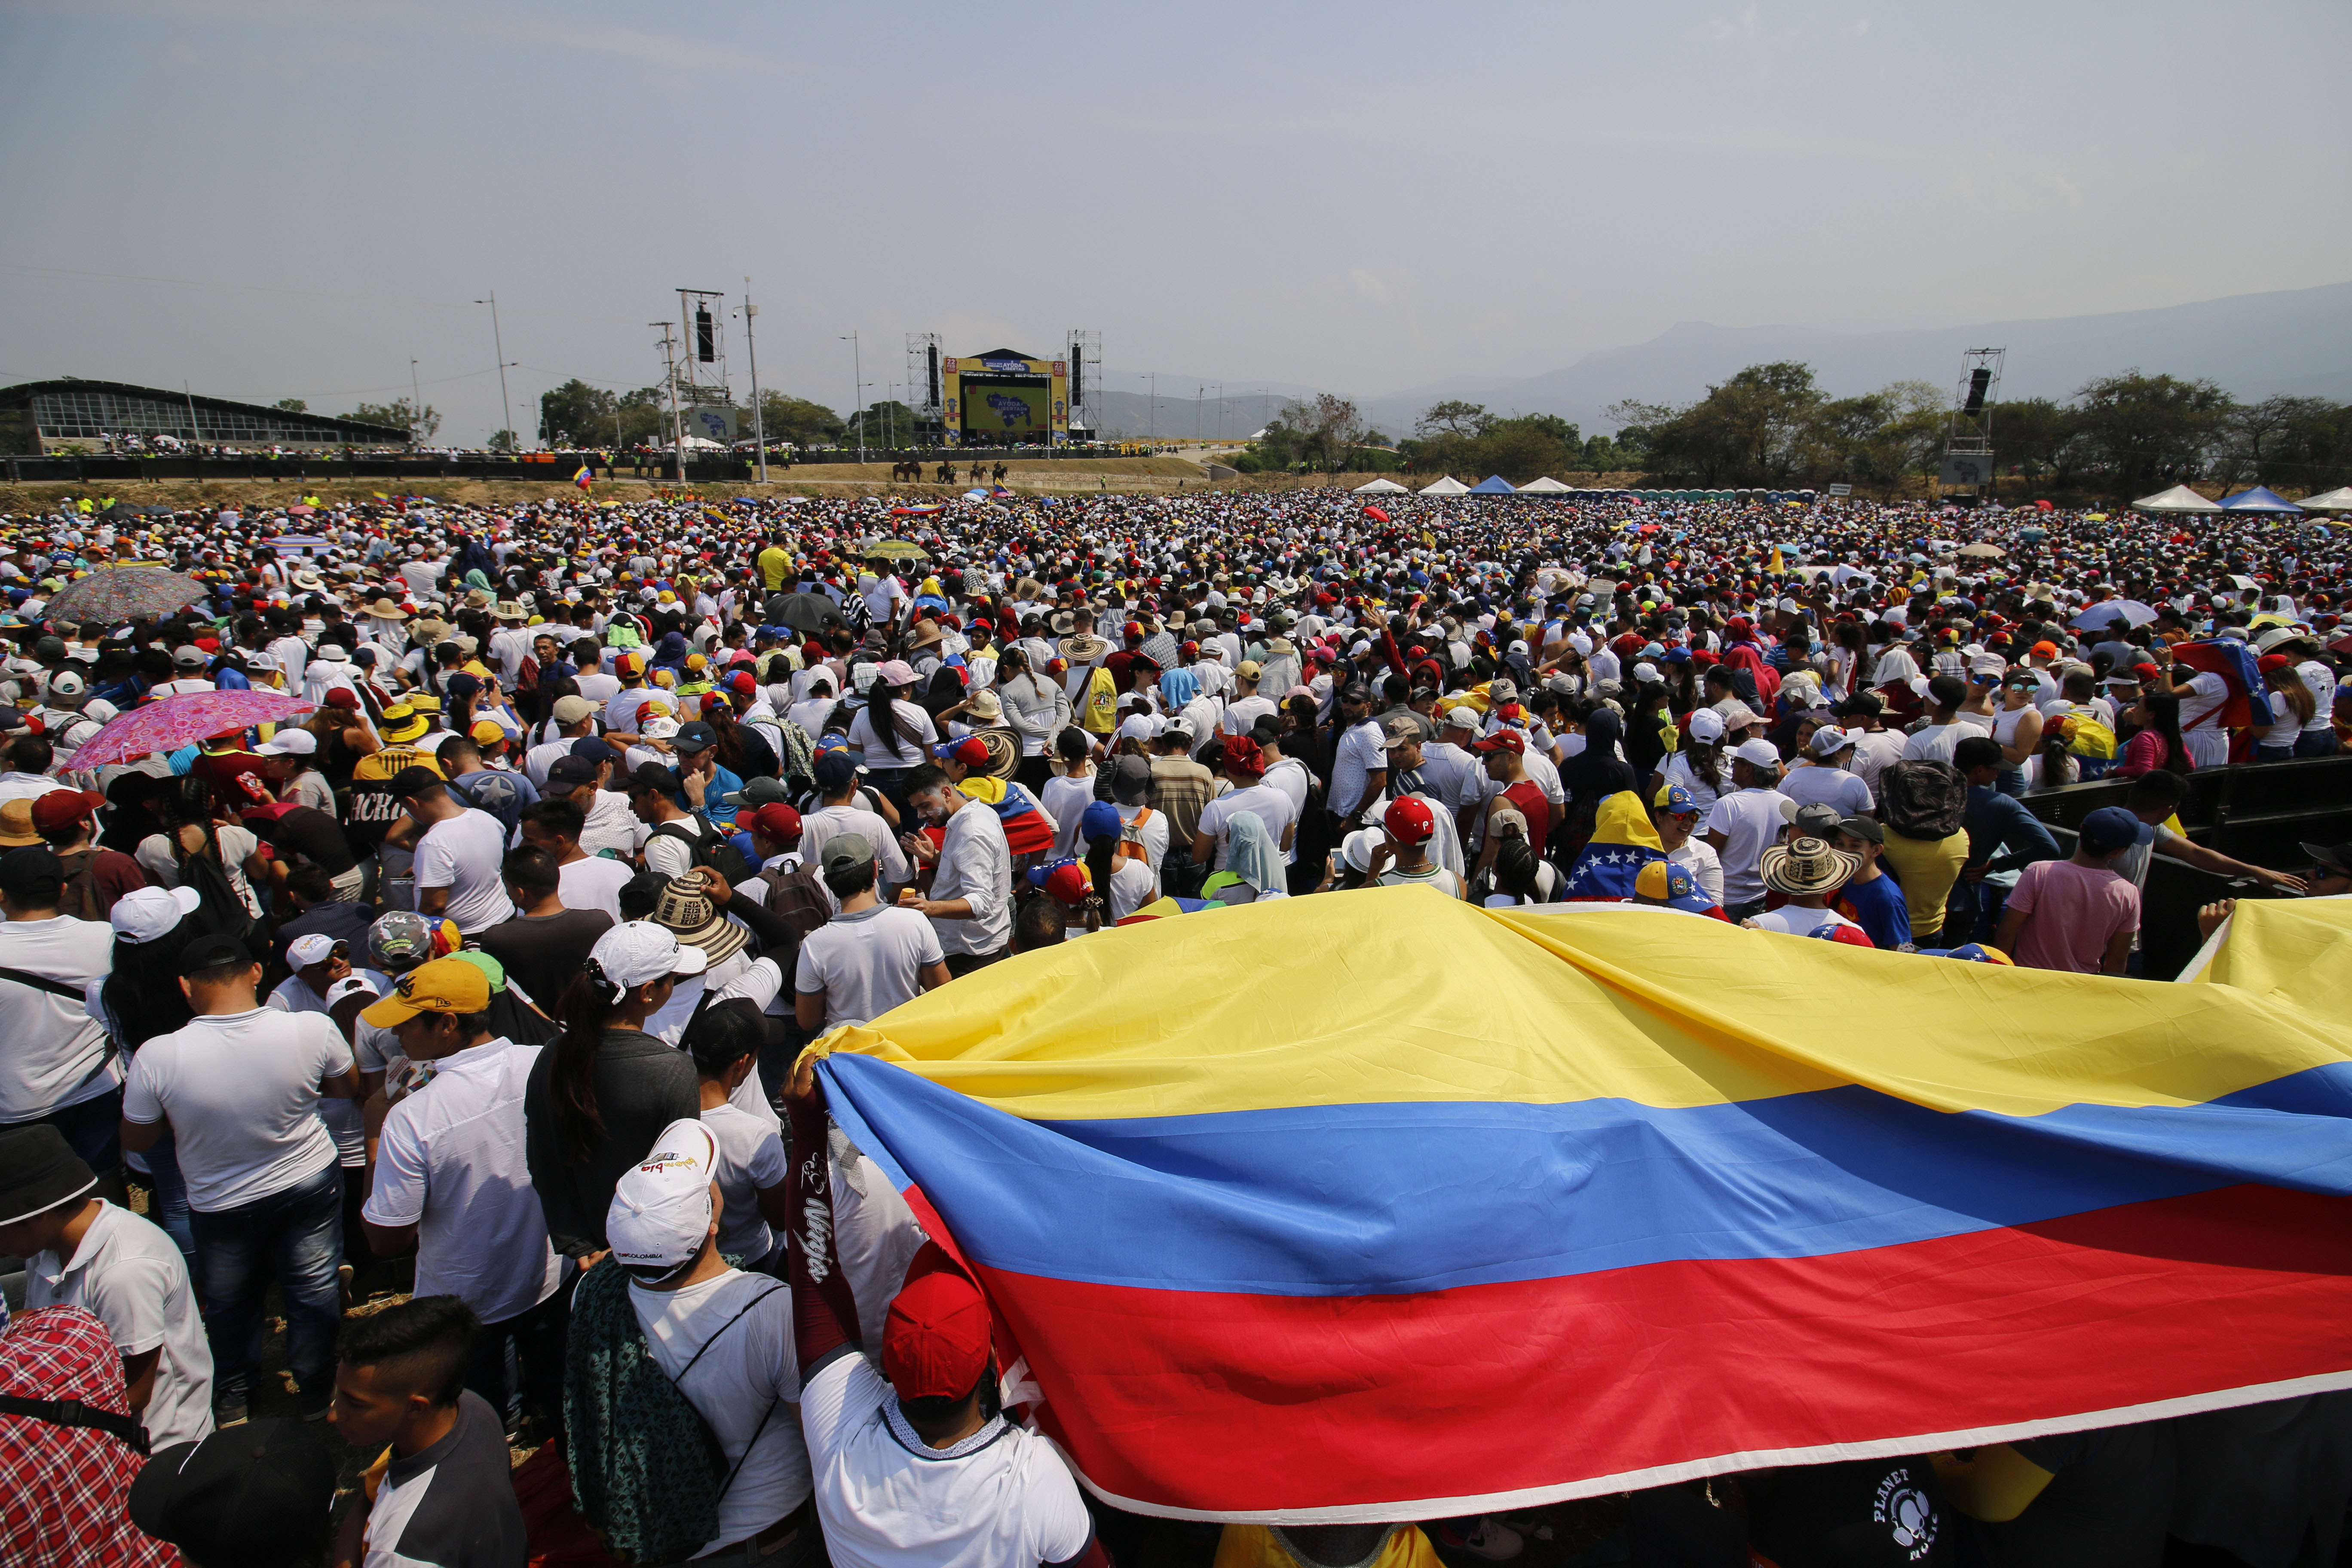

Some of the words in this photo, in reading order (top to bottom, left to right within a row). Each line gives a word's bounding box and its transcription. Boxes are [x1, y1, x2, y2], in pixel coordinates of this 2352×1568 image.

[1422, 821, 1429, 831] P
[793, 1197, 833, 1283] Ninja
[1874, 1469, 1909, 1523] PLANET
[1910, 1513, 1938, 1561] MUSIC
